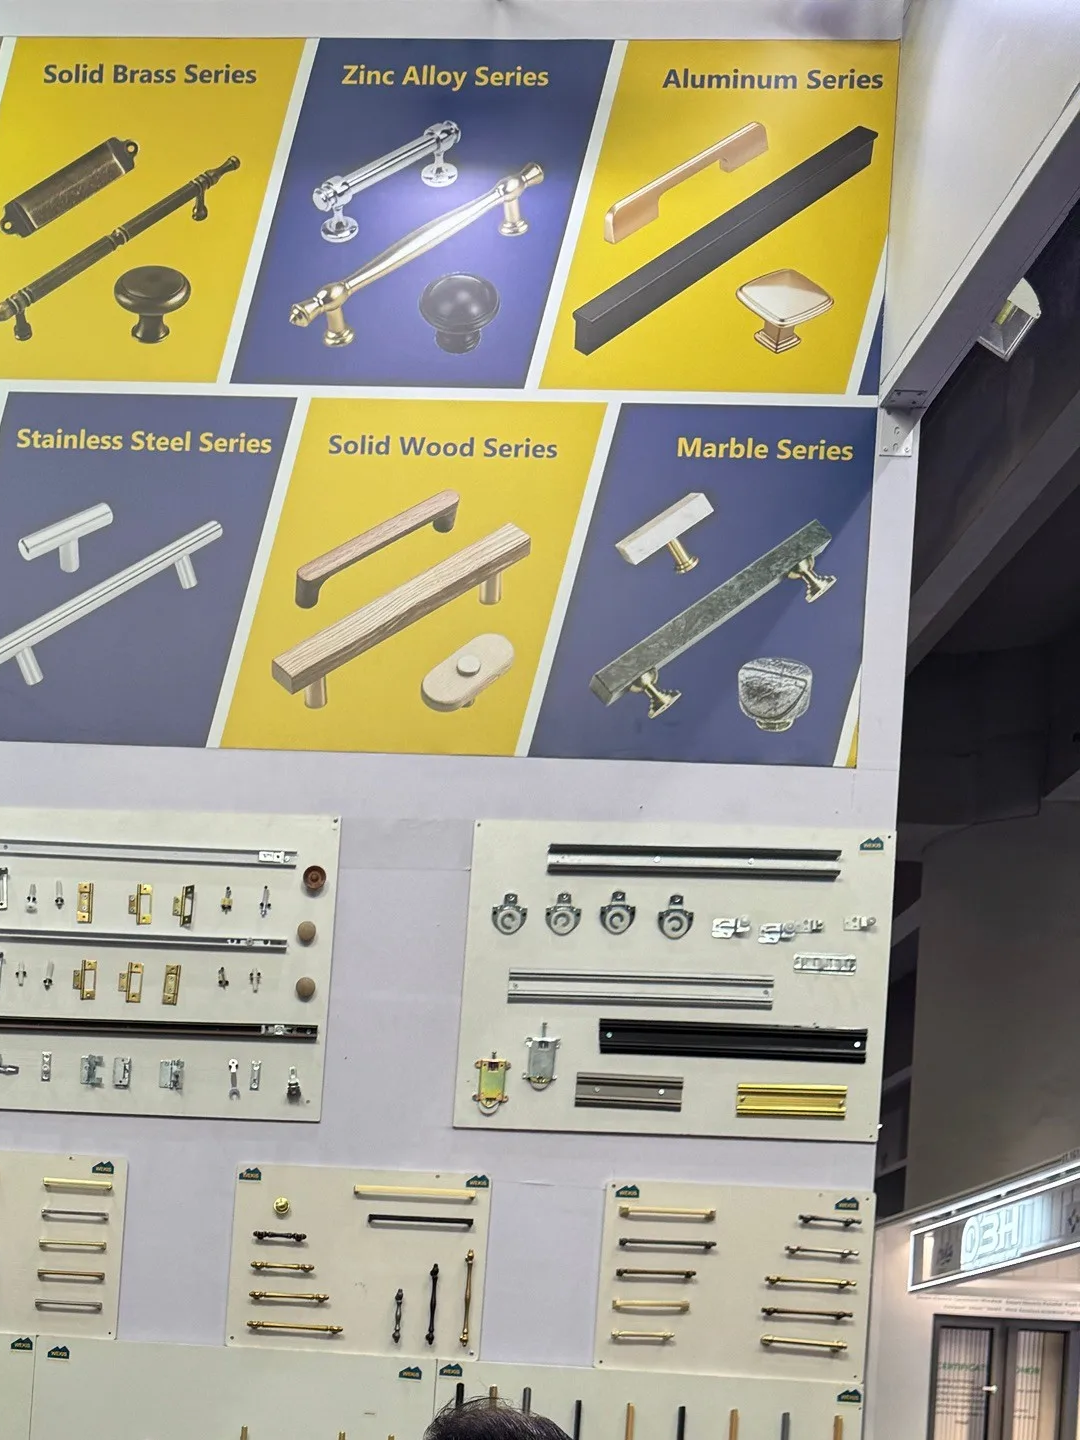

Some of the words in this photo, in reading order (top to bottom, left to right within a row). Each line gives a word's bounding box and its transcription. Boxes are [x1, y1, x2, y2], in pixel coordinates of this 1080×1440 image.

[42, 63, 105, 85] Solid
[111, 64, 177, 85] Brass
[183, 63, 257, 85] Series
[341, 63, 394, 87] Zinc
[401, 65, 468, 92] Alloy
[474, 66, 549, 87] Series
[661, 69, 800, 92] Aluminum
[805, 68, 884, 91] Series
[16, 427, 124, 451] Stainless
[130, 429, 192, 452] Steel
[198, 431, 273, 455] Series
[328, 433, 392, 457] Solid
[398, 435, 476, 459] Wood
[483, 436, 558, 460] Series
[676, 436, 769, 460] Marble
[776, 438, 854, 462] Series
